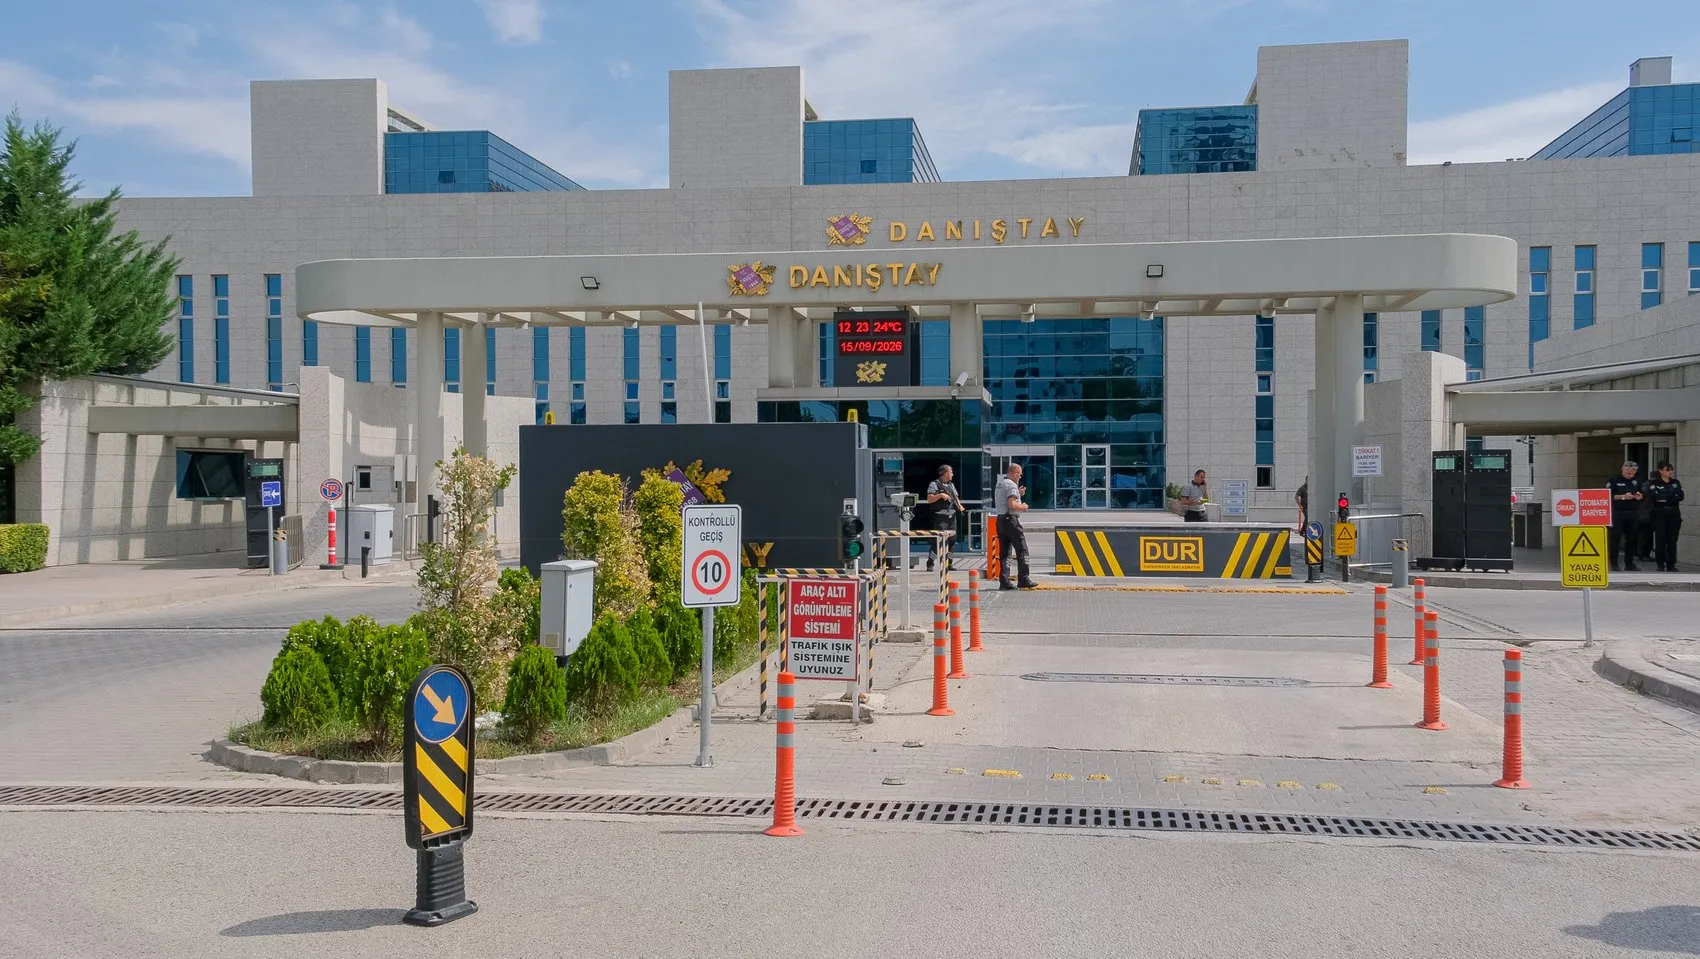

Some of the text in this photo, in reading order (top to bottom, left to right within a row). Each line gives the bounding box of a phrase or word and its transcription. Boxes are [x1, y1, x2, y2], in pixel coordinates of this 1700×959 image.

[889, 217, 1086, 244] DANIŞTAY
[789, 262, 943, 292] DANIŞTAY
[838, 322, 851, 333] 12
[856, 322, 870, 333] 23
[841, 341, 903, 352] 15/09/2026
[1557, 503, 1575, 511] DİKKAT
[1580, 498, 1609, 507] OTOMATİK
[1582, 508, 1607, 517] BARİYER
[688, 515, 736, 527] KONTROLLÜ
[700, 530, 723, 543] GEÇİŞ
[1145, 542, 1197, 561] DUR
[701, 561, 722, 583] 10
[1569, 563, 1600, 573] YAVAŞ
[1568, 573, 1602, 582] SÜRÜN
[800, 585, 846, 600] ARAÇ ALTI
[793, 601, 852, 617] GÖRÜNTÜLEME
[804, 619, 841, 634] SİSTEMİ
[791, 640, 853, 653] TRAFİK IŞIK
[793, 651, 850, 663] SİSTEMİNE
[799, 665, 844, 674] UYUNUZ
